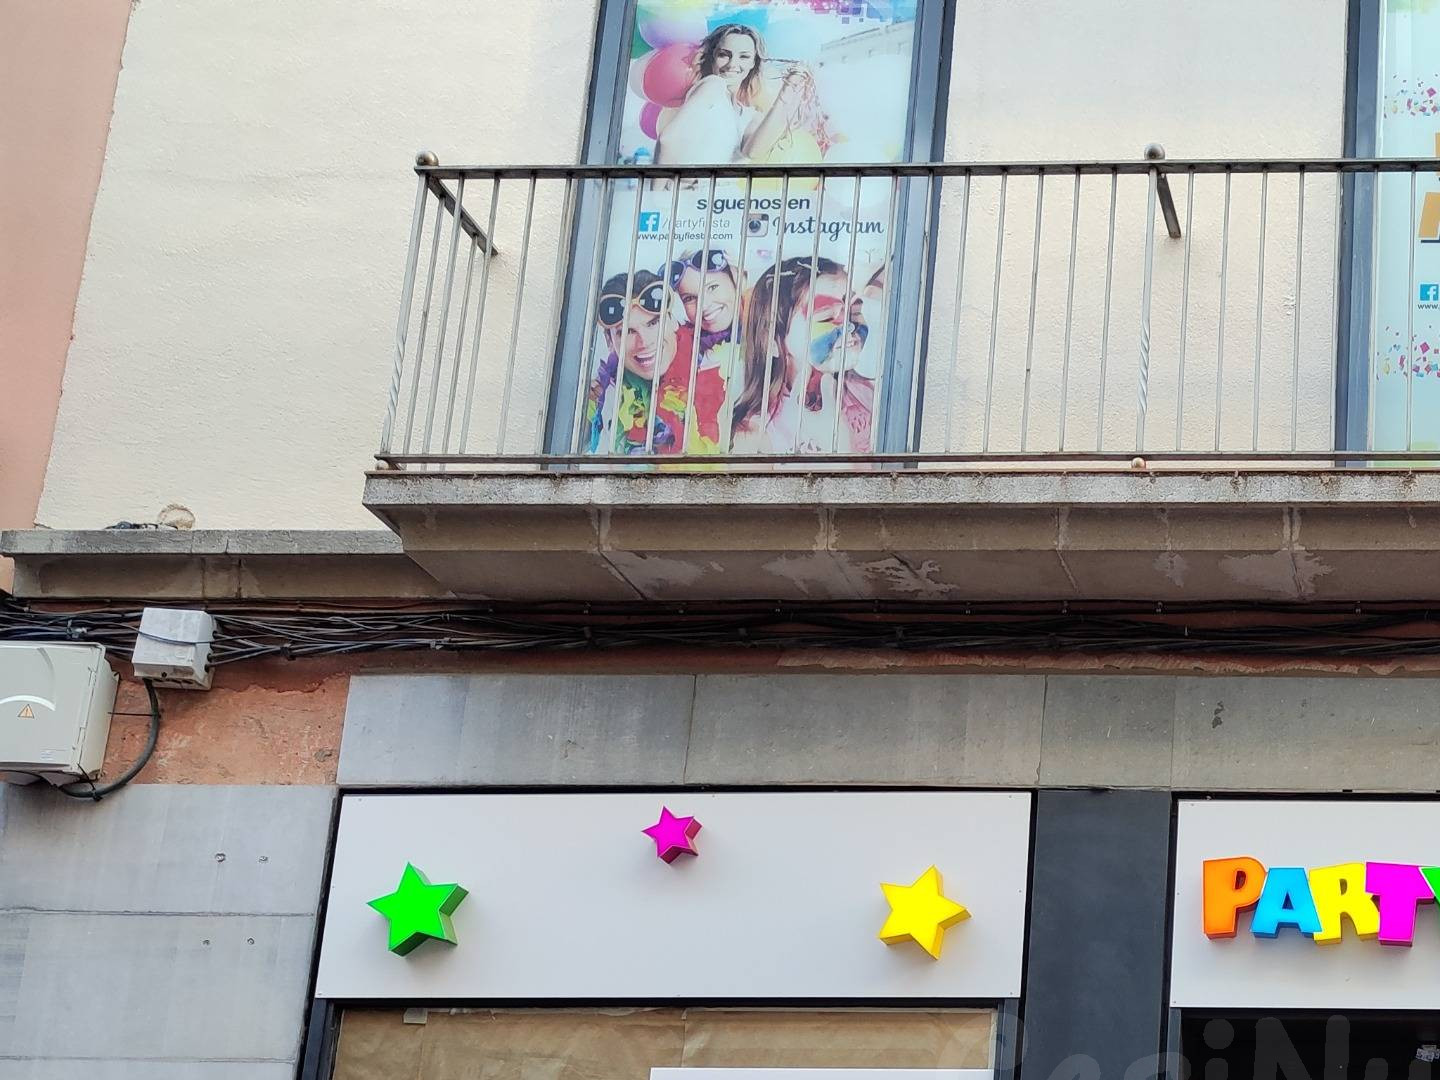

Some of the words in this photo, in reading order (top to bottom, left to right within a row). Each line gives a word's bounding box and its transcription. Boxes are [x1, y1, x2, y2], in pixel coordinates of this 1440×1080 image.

[696, 198, 782, 214] sguenos
[788, 198, 810, 210] en
[772, 216, 885, 241] Instagram
